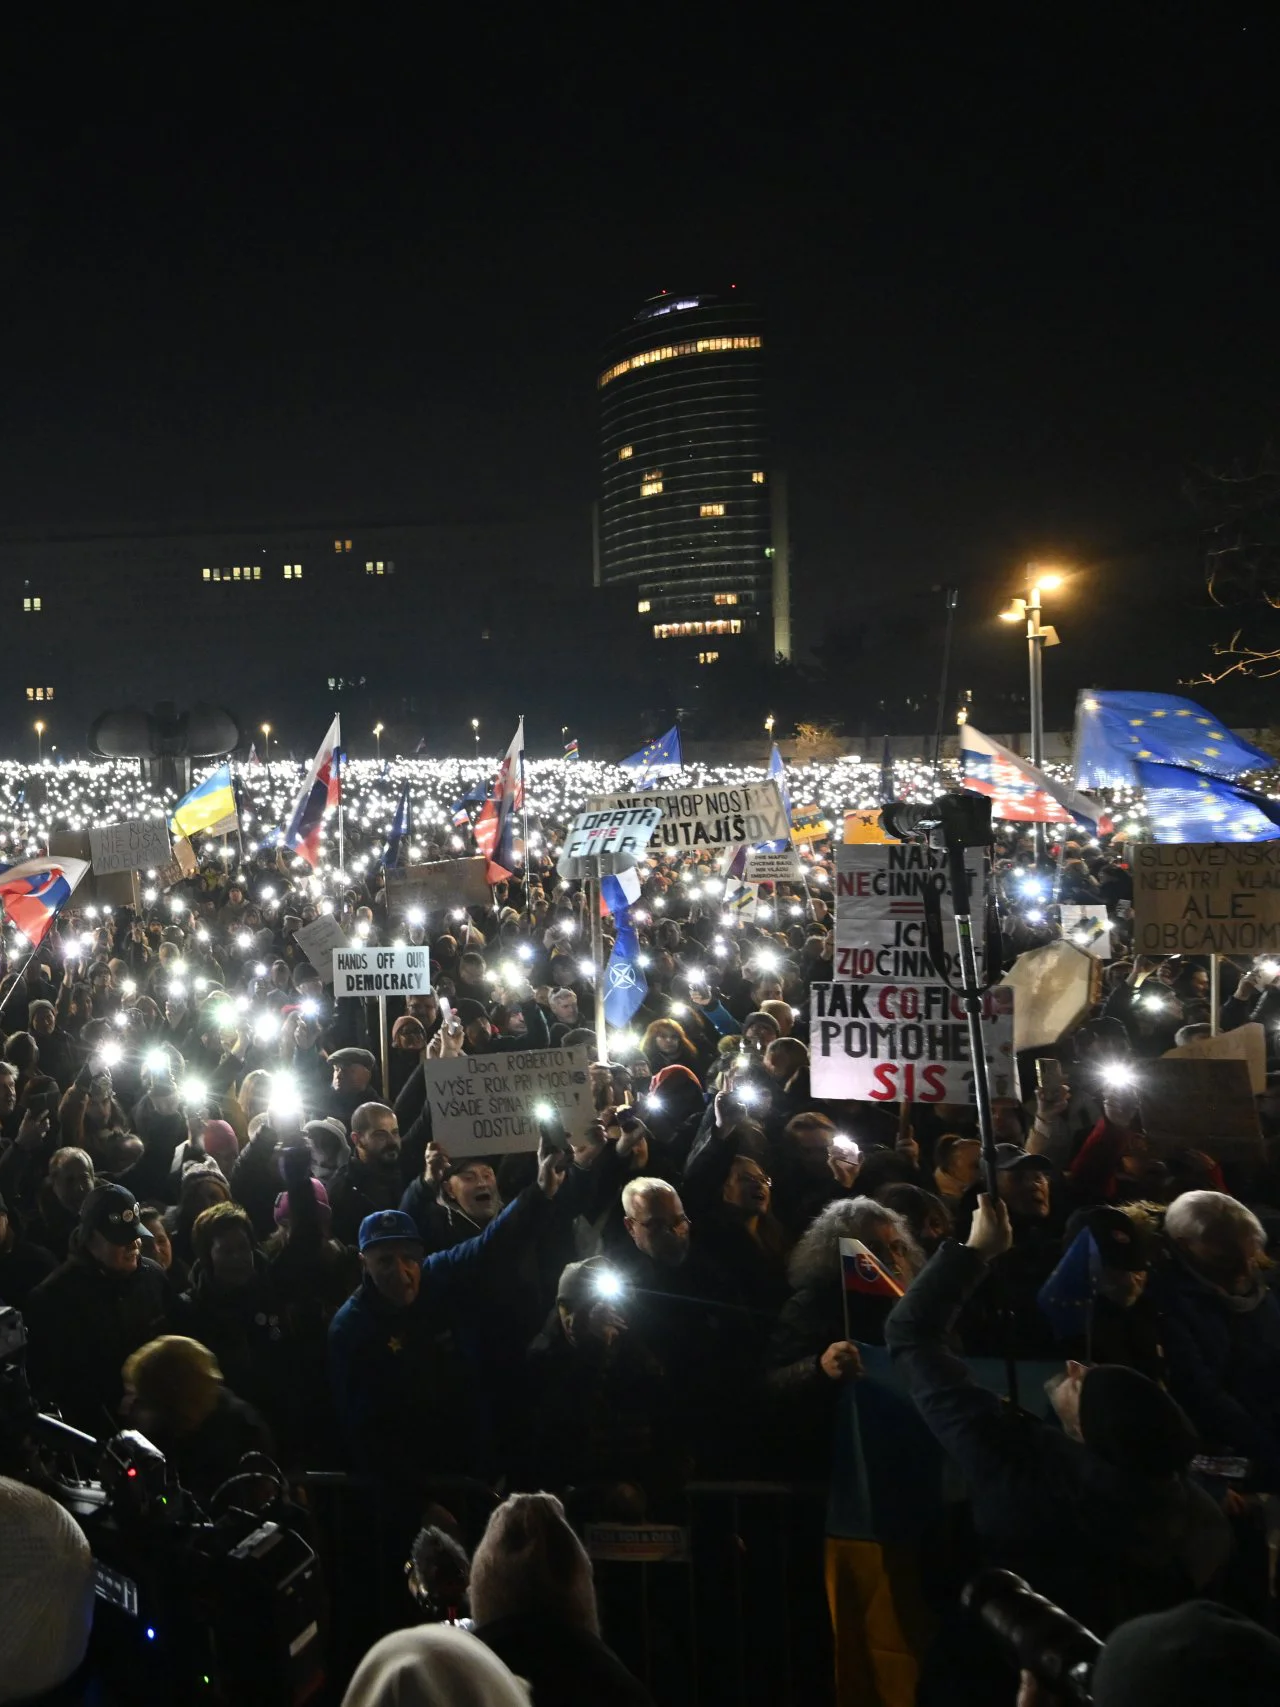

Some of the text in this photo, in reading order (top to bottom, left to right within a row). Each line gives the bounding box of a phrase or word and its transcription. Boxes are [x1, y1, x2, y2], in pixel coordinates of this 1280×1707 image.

[101, 833, 162, 854] NIE USA
[1182, 893, 1257, 919] ALE
[338, 951, 425, 970] HANDS OFF OUR
[346, 972, 424, 991] DEMOCRACY
[812, 984, 872, 1018] TAK
[435, 1076, 476, 1097] VYŠE
[484, 1073, 511, 1094] ROK
[868, 1063, 947, 1103] SIS
[437, 1096, 484, 1118] VŠADE
